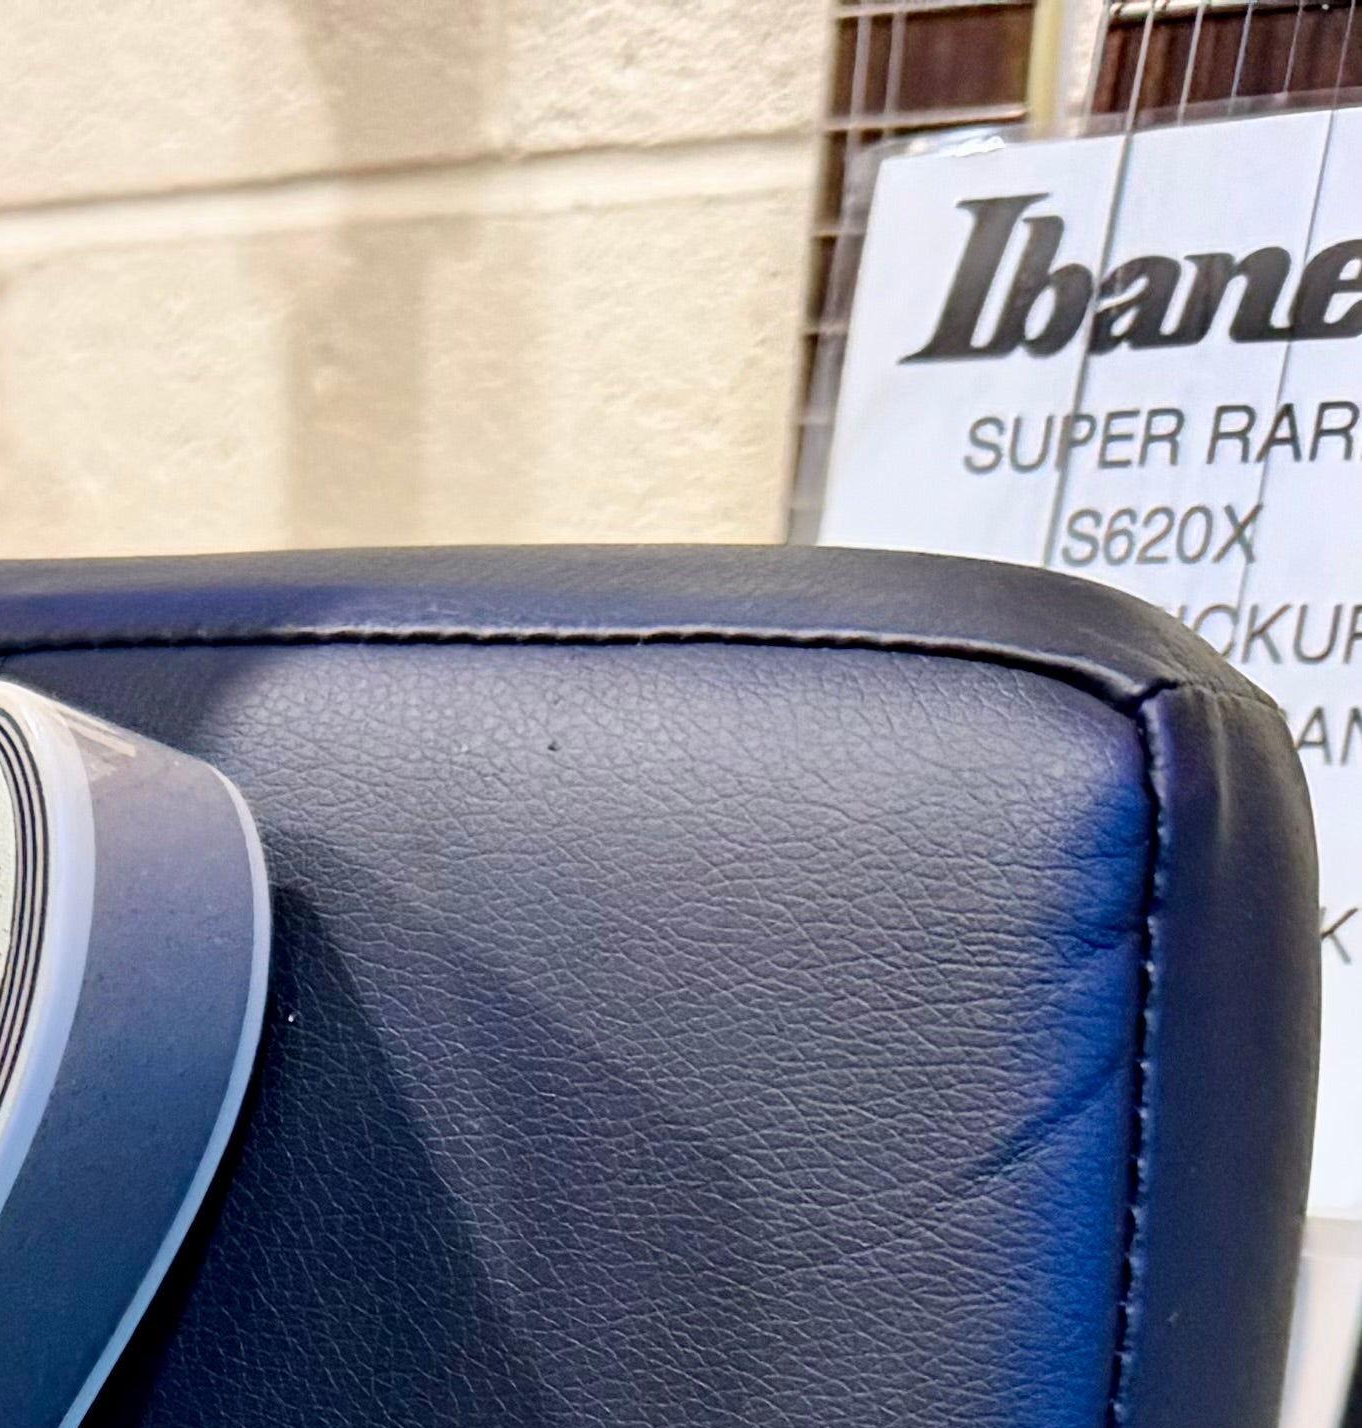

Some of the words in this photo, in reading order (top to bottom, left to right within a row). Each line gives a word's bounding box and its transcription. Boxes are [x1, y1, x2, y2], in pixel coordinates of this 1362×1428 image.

[897, 192, 1362, 366] Ibane
[962, 407, 1185, 475] SUPER
[1206, 400, 1362, 465] RAR
[1060, 502, 1264, 568] S620X
